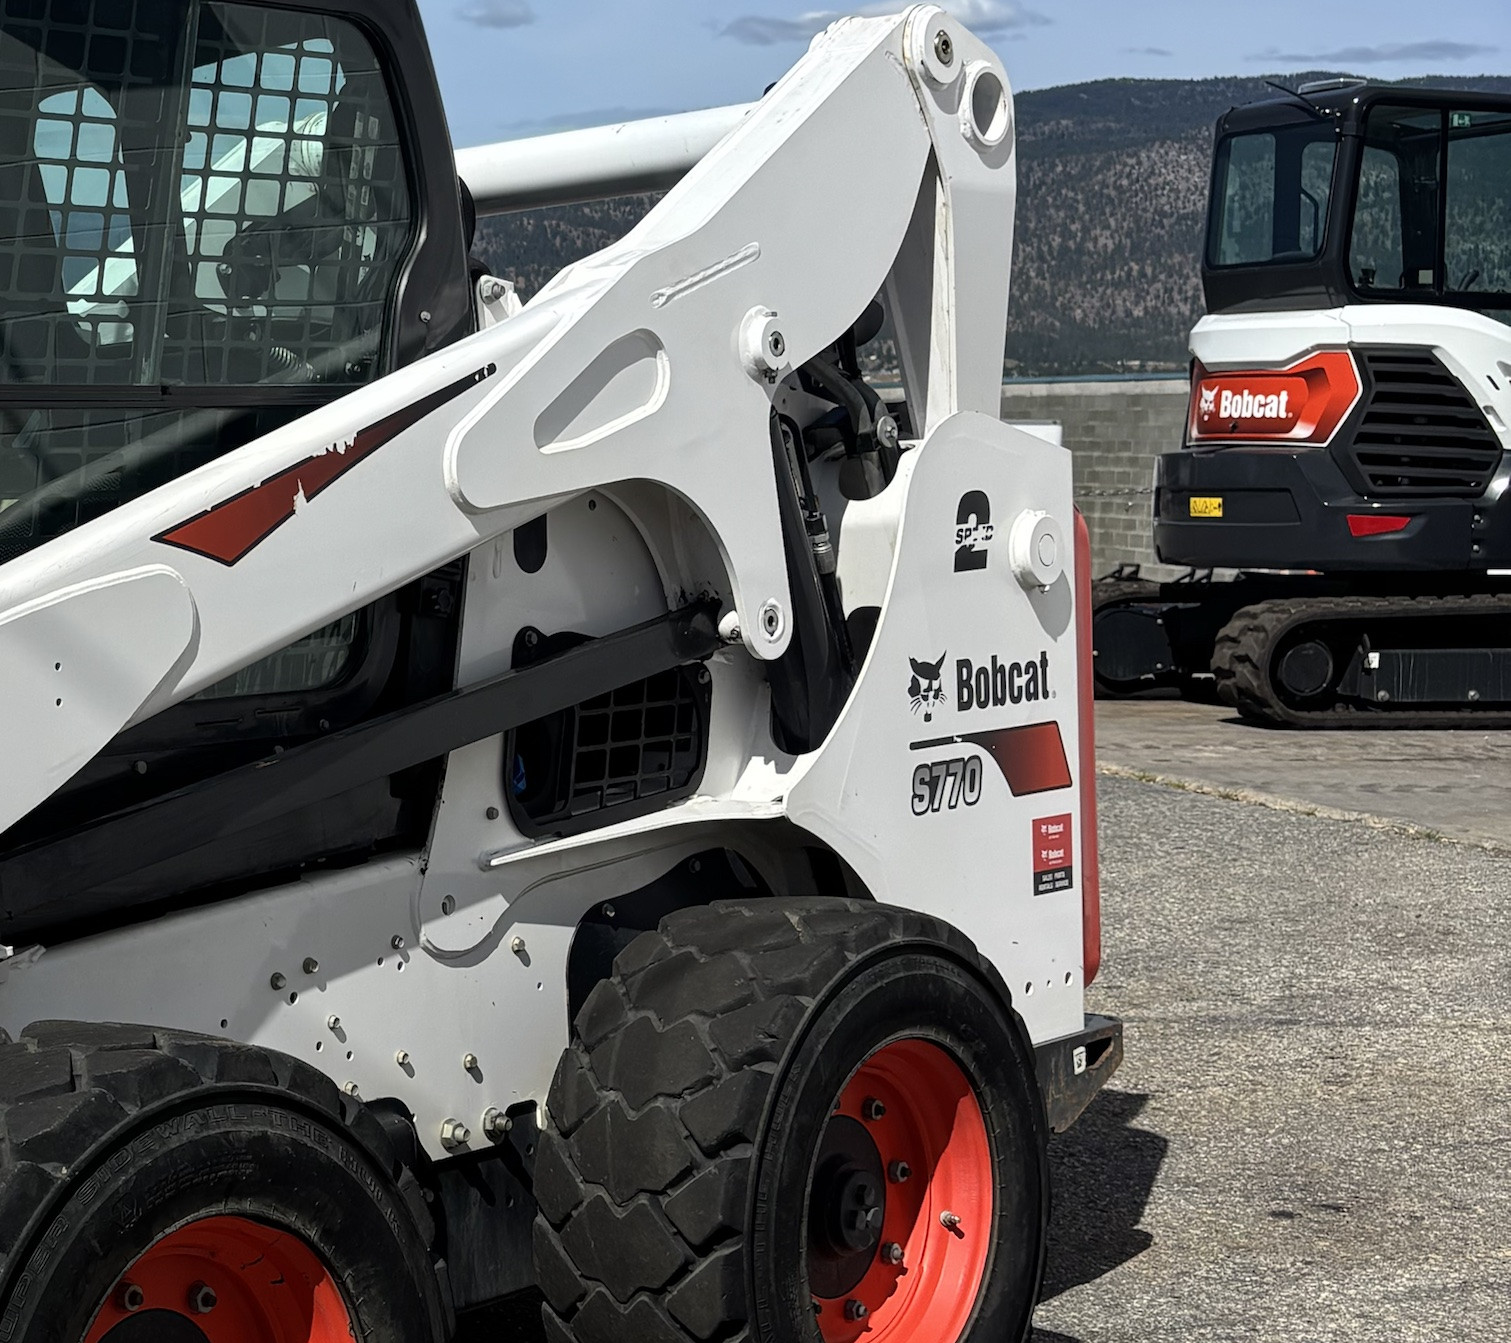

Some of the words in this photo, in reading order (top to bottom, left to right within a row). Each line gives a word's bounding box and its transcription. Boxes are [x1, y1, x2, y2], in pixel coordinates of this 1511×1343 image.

[1219, 389, 1288, 419] Bobcat
[954, 490, 990, 572] 2
[955, 525, 994, 544] SPD
[955, 650, 1050, 712] Bobcat
[911, 754, 983, 816] S770
[75, 1105, 248, 1207] SIDEWALL
